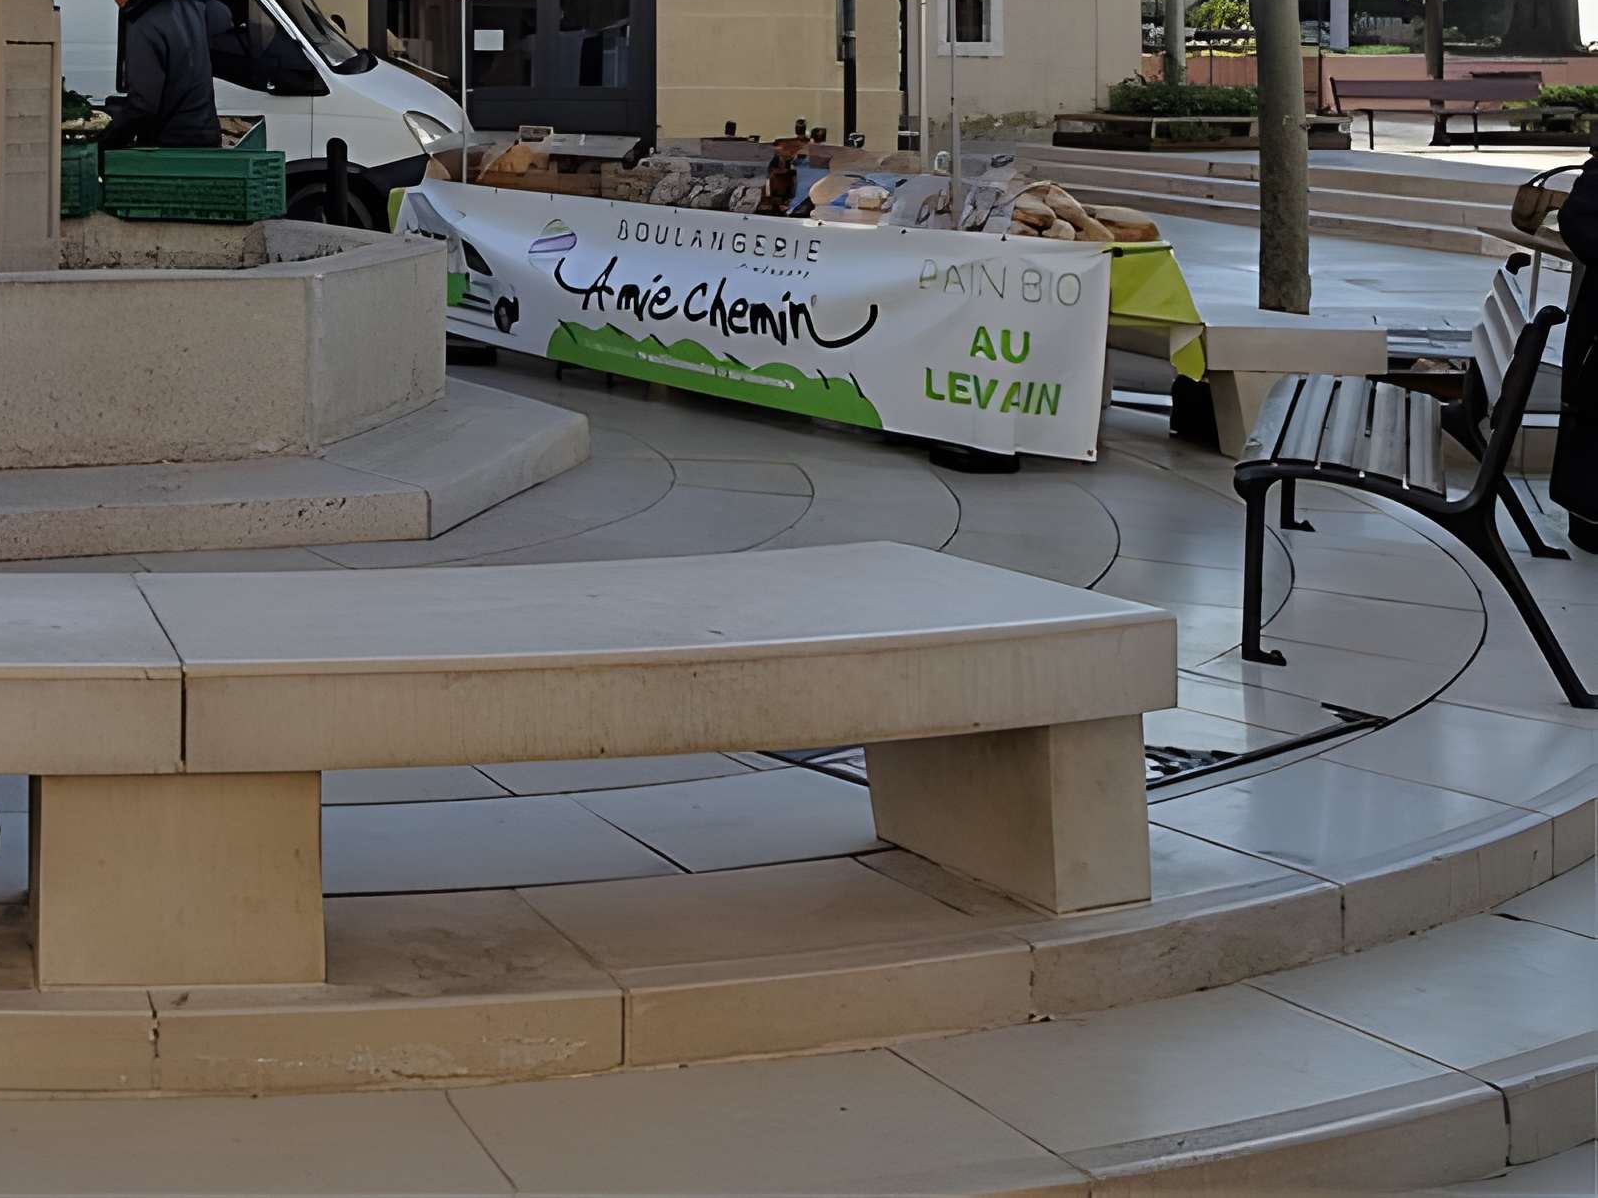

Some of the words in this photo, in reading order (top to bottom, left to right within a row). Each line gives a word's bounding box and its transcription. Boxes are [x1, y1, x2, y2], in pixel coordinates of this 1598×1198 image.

[616, 218, 822, 263] BOULANGERIE
[918, 259, 1007, 299] PAIN
[1021, 269, 1082, 306] BIO
[969, 325, 1031, 364] AU
[924, 367, 1062, 416] LEVAIN
